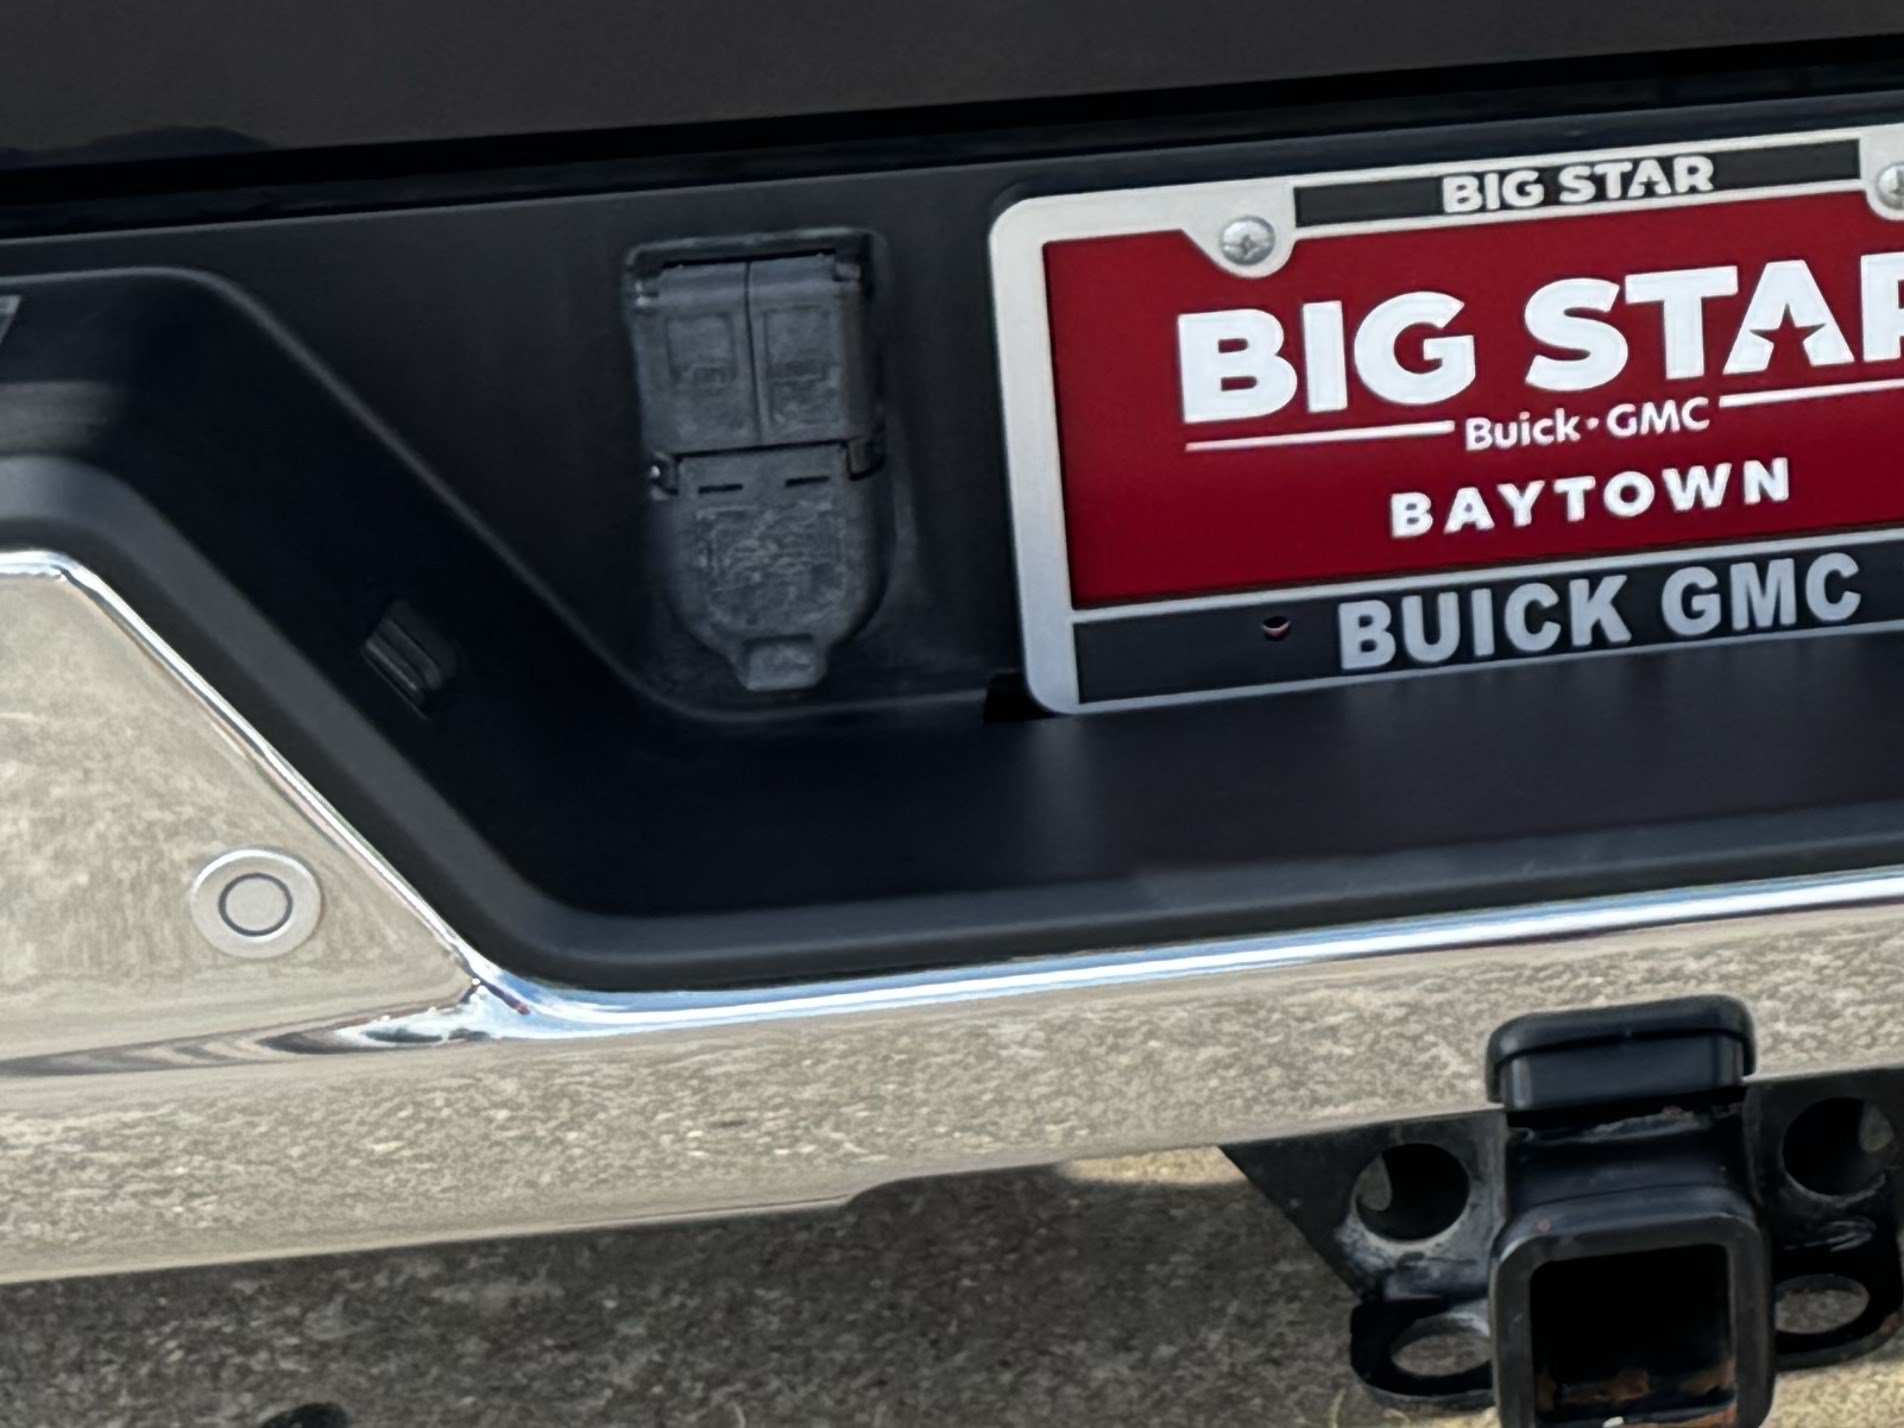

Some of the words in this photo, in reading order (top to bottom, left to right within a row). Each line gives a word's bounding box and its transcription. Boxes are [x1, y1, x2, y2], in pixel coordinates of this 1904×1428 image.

[1442, 170, 1544, 215] BIG
[1557, 154, 1715, 204] STAR
[1177, 291, 1477, 423] BIG
[1465, 409, 1582, 451] Buick
[1606, 395, 1711, 440] GMC
[1389, 457, 1792, 539] BAYTOWN
[1338, 576, 1633, 671] BUICK
[1661, 551, 1863, 637] GMC
